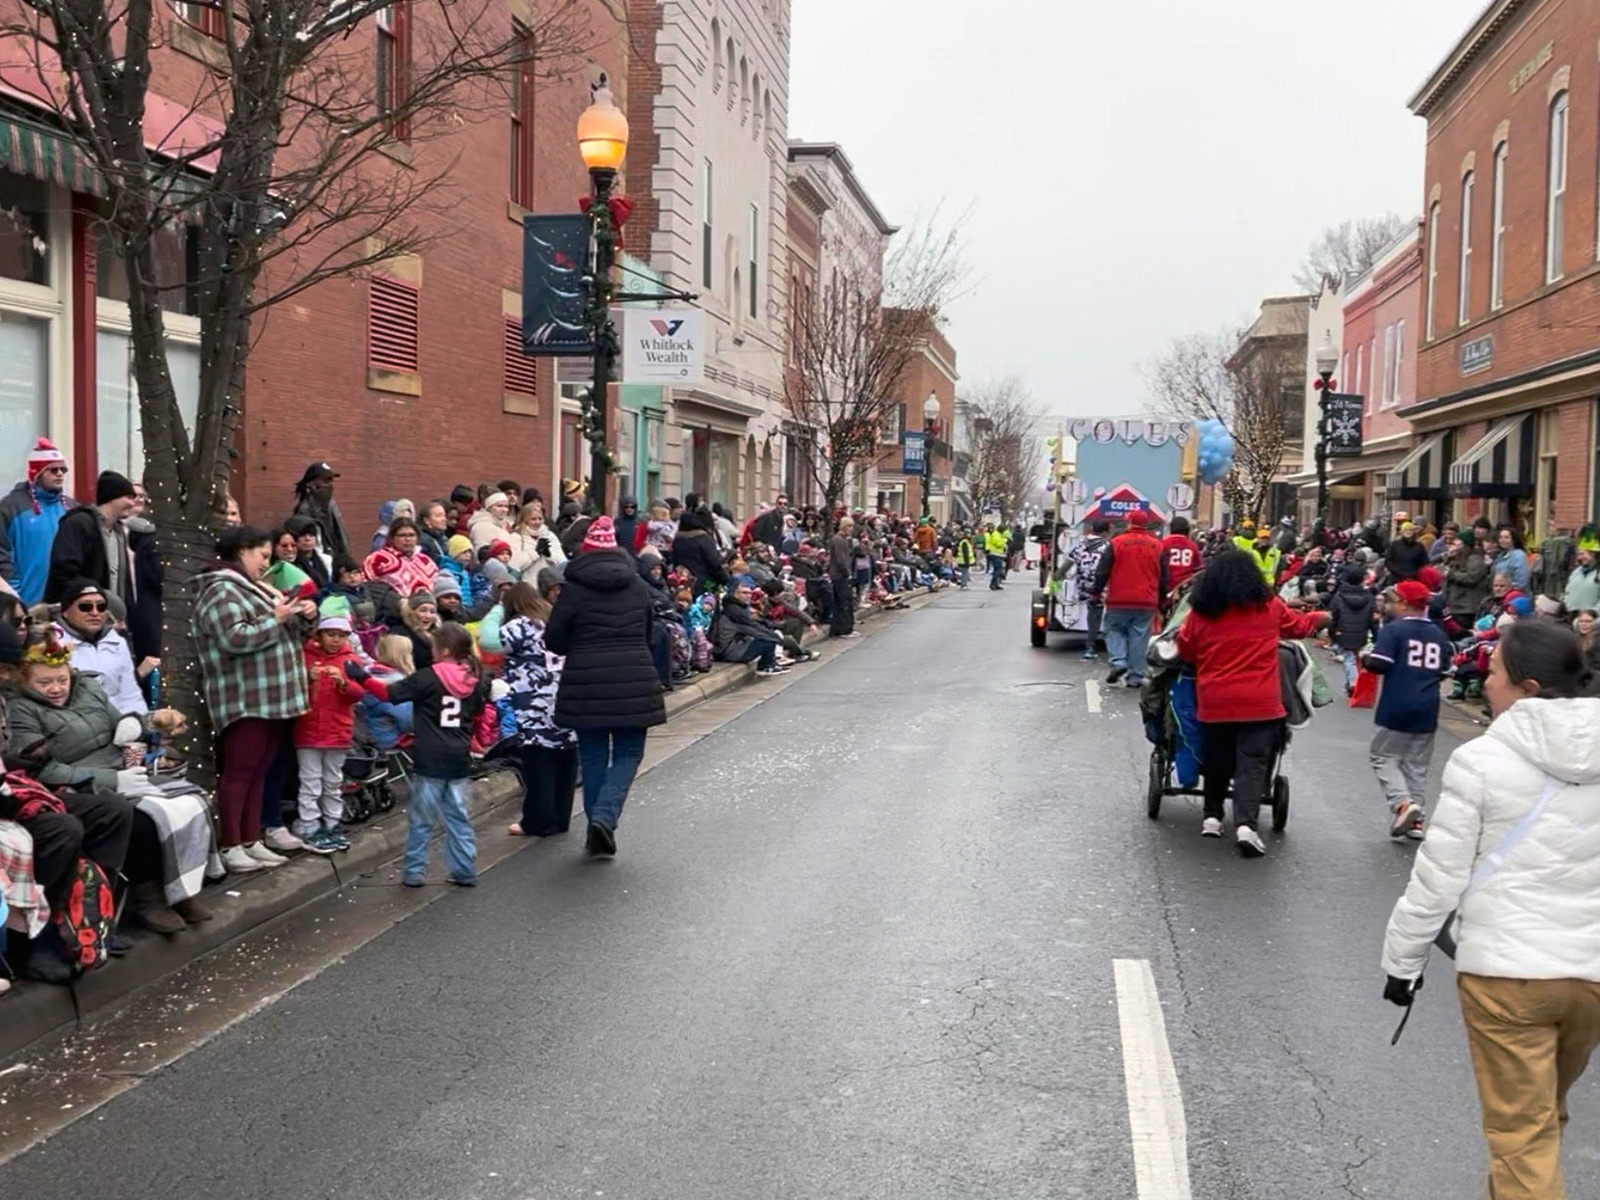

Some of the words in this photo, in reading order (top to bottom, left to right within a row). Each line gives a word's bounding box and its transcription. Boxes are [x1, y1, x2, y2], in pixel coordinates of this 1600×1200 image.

[640, 339, 694, 351] Whitlock
[646, 352, 689, 363] Wealth
[1069, 420, 1190, 443] COLES
[1111, 501, 1141, 510] COLES
[1169, 548, 1193, 566] 28
[1408, 639, 1441, 669] 28
[440, 695, 461, 728] 2
